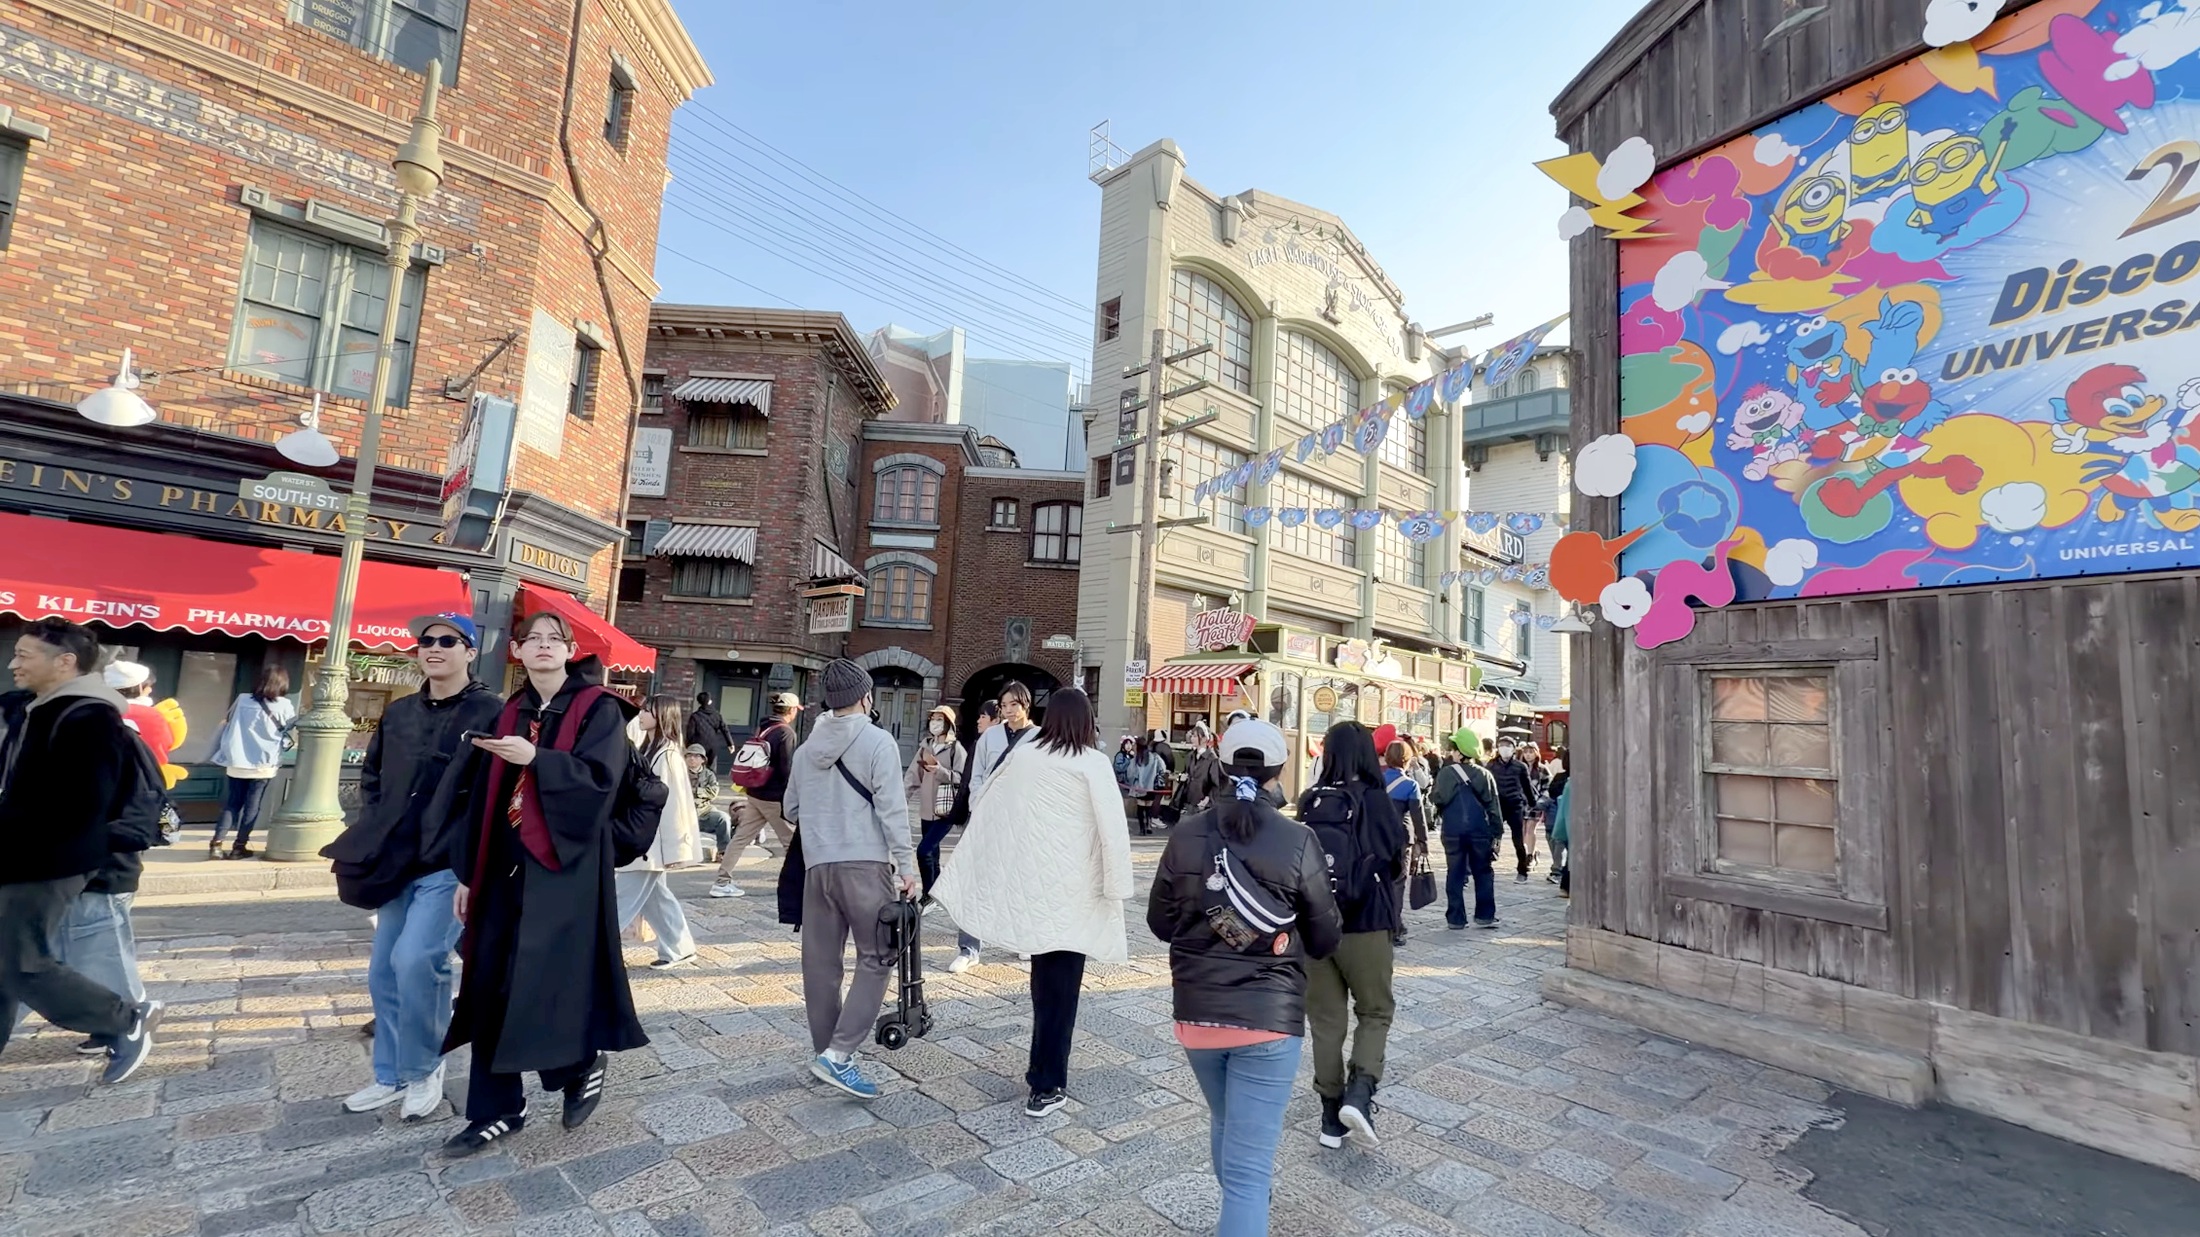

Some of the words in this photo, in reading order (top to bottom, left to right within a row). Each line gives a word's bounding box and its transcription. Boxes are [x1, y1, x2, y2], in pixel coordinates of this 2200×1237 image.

[311, 2, 352, 25] DRUGGIST
[313, 18, 347, 39] BROKER
[2116, 139, 2200, 241] 2
[1249, 246, 1280, 269] EAGLE
[1284, 246, 1342, 283] WAREHOUSE
[281, 476, 304, 486] WATER
[253, 485, 312, 505] SOUTH
[316, 494, 340, 509] ST.
[522, 544, 579, 577] DRUGS
[2060, 538, 2194, 561] UNIVERSAL
[37, 595, 160, 619] KLEIN'S
[187, 608, 331, 633] PHARMACY
[811, 598, 849, 629] HARDWARE
[1195, 610, 1241, 631] Trolley
[1066, 641, 1075, 649] ST.
[1196, 625, 1236, 648] Treats
